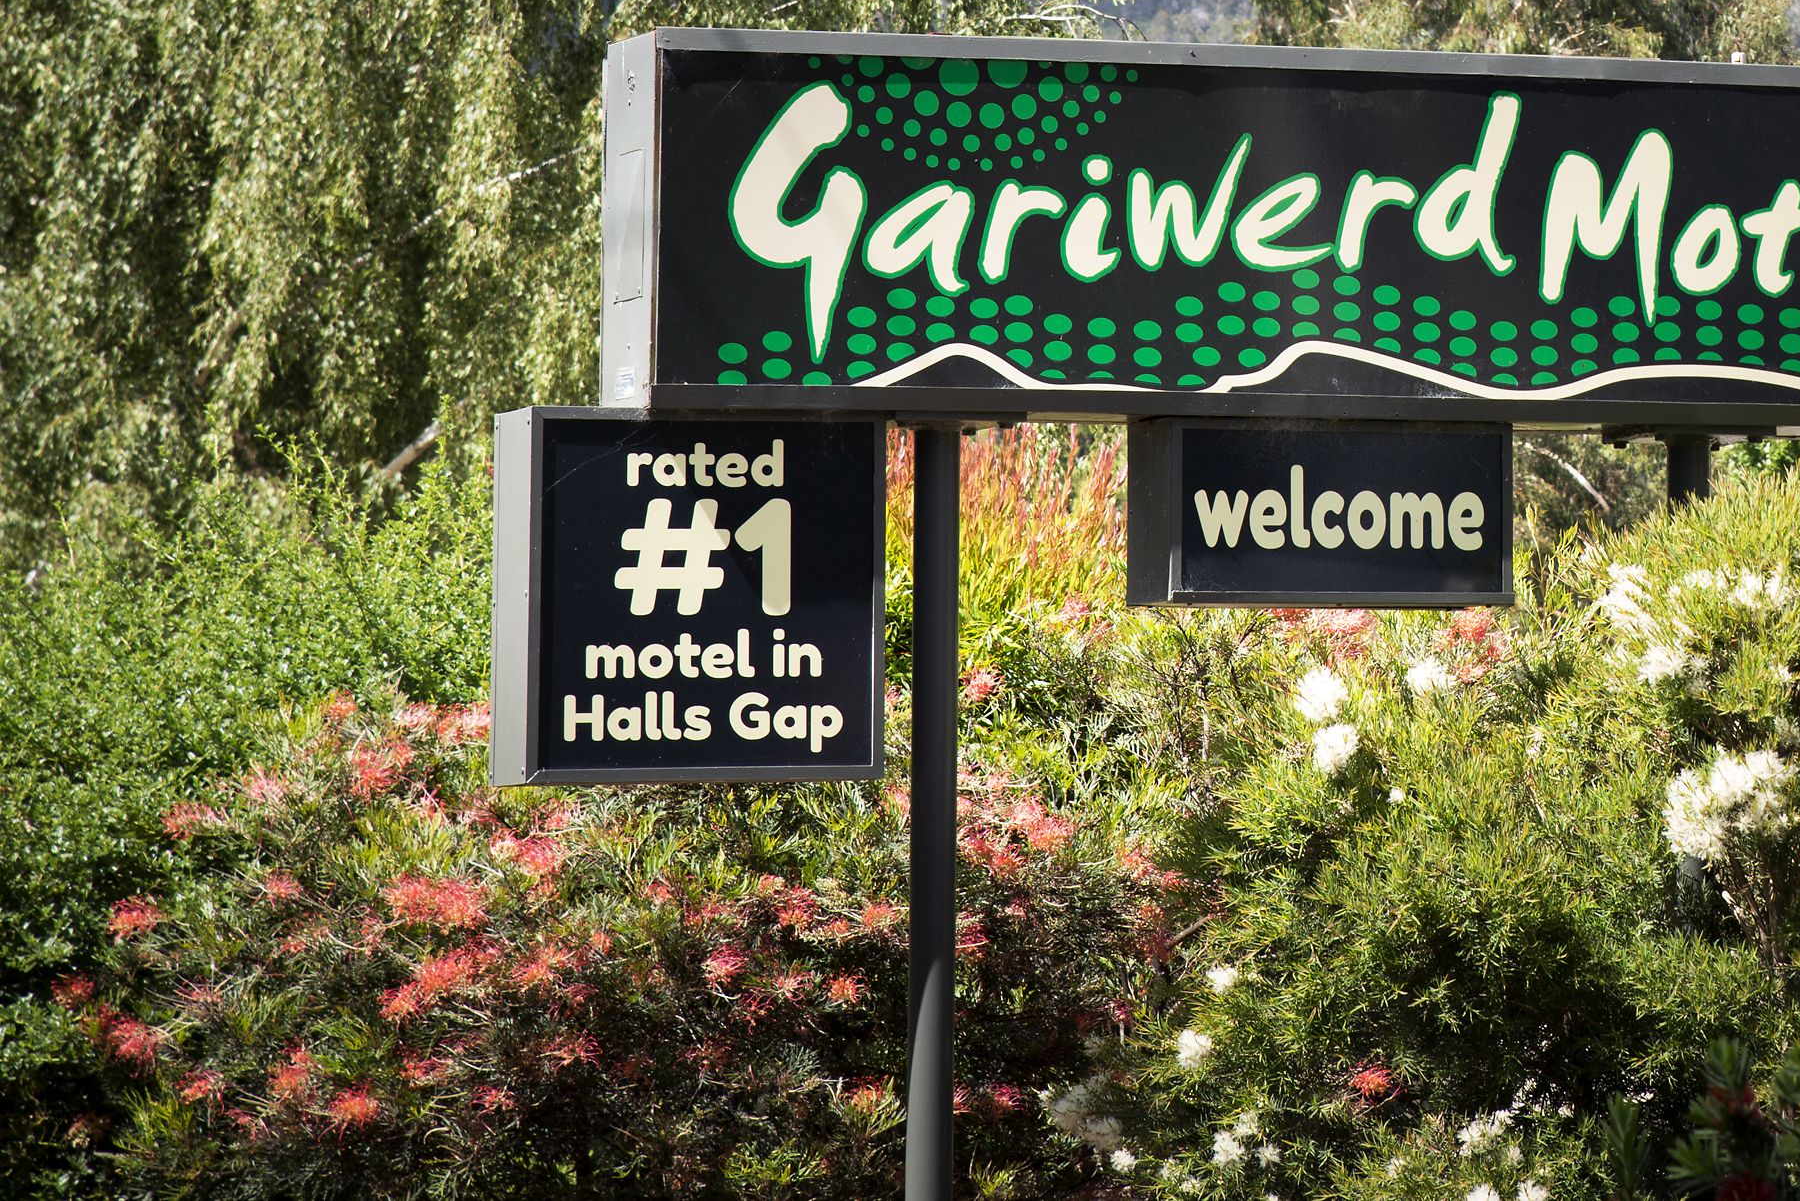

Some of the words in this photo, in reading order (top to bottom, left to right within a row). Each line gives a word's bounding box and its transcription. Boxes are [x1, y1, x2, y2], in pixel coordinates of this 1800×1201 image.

[732, 82, 1521, 363] Gariwerd
[626, 438, 785, 488] rated
[1194, 464, 1486, 551] welcome
[614, 498, 792, 617] #1
[585, 628, 756, 679] motel
[772, 628, 823, 678] in
[563, 690, 712, 743] Halls
[728, 691, 844, 753] Gap
